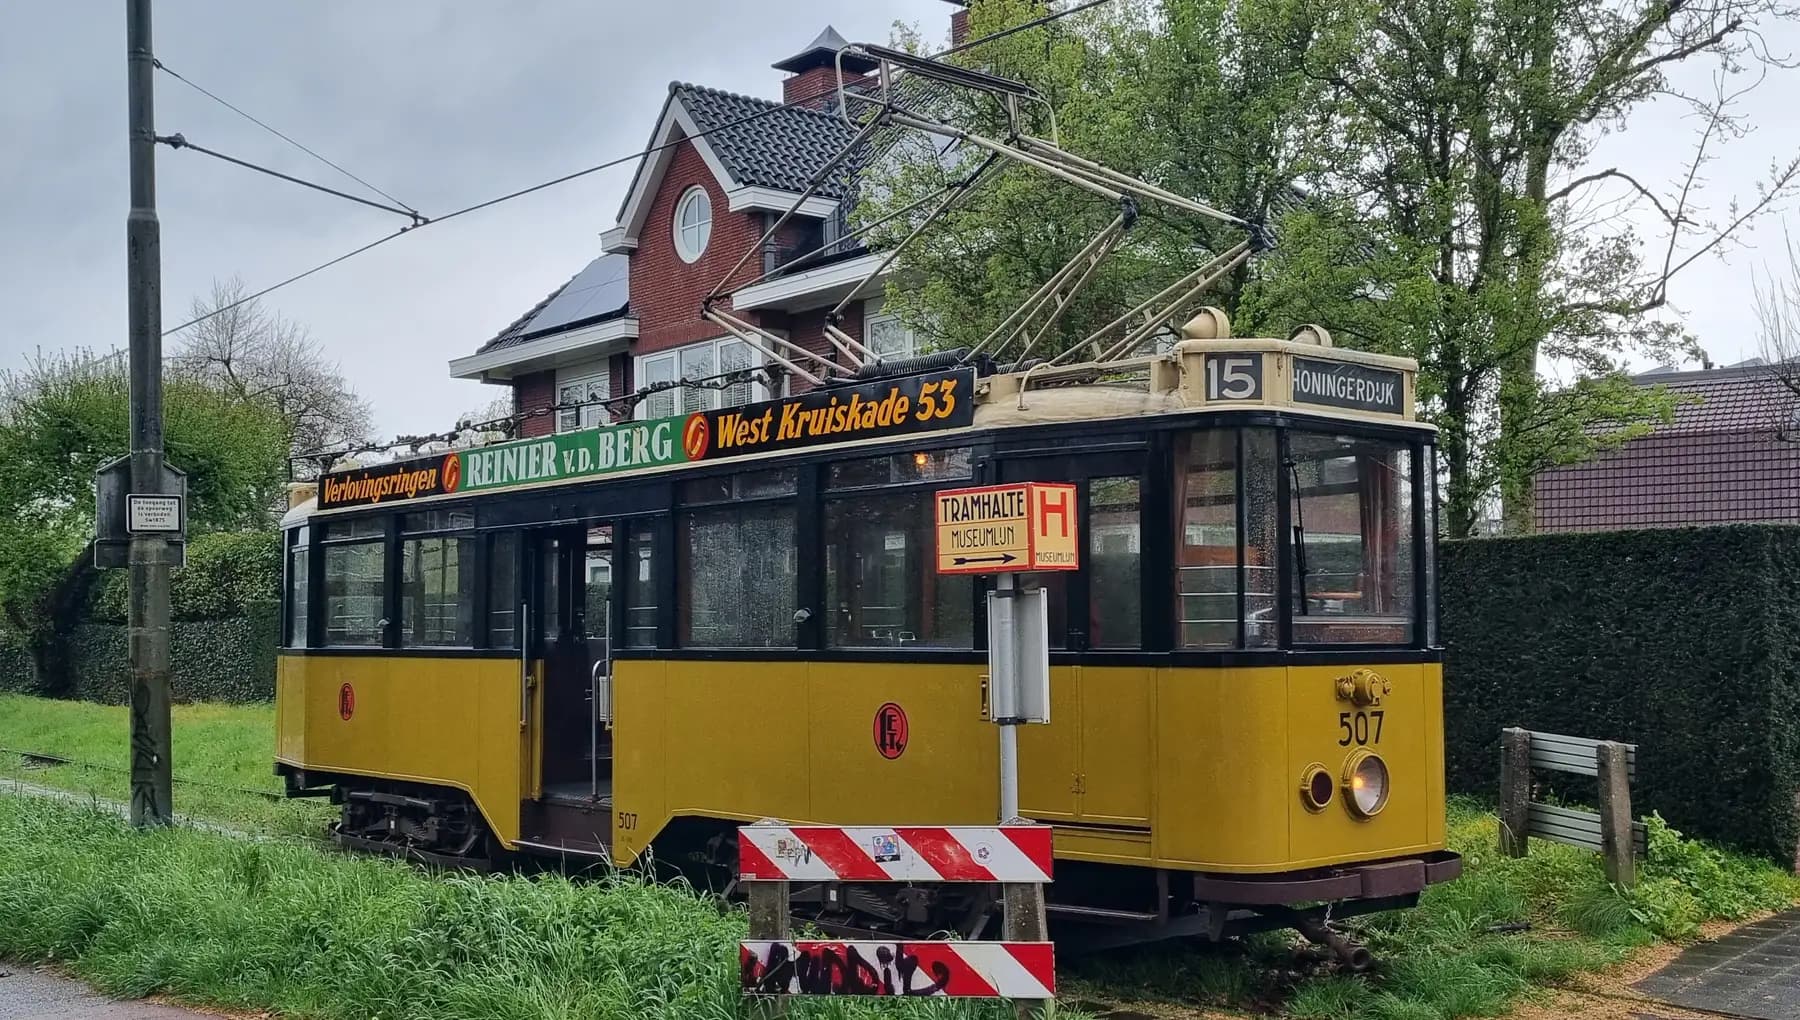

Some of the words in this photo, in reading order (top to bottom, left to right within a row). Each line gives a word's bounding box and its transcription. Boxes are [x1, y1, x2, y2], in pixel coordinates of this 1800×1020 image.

[1207, 358, 1256, 400] 15
[717, 411, 772, 449] West
[777, 387, 909, 441] Kruiskade
[915, 378, 957, 421] 53
[466, 441, 557, 488] REINIER
[598, 422, 673, 469] BERG
[323, 467, 437, 504] Verlovingsringen
[941, 491, 1025, 522] TRAMHALTE
[1040, 490, 1068, 537] H
[952, 526, 1014, 548] MUSEUMLIJN
[1036, 552, 1074, 563] MUSEUMLIJN
[1338, 711, 1384, 746] 507
[618, 812, 638, 830] 507
